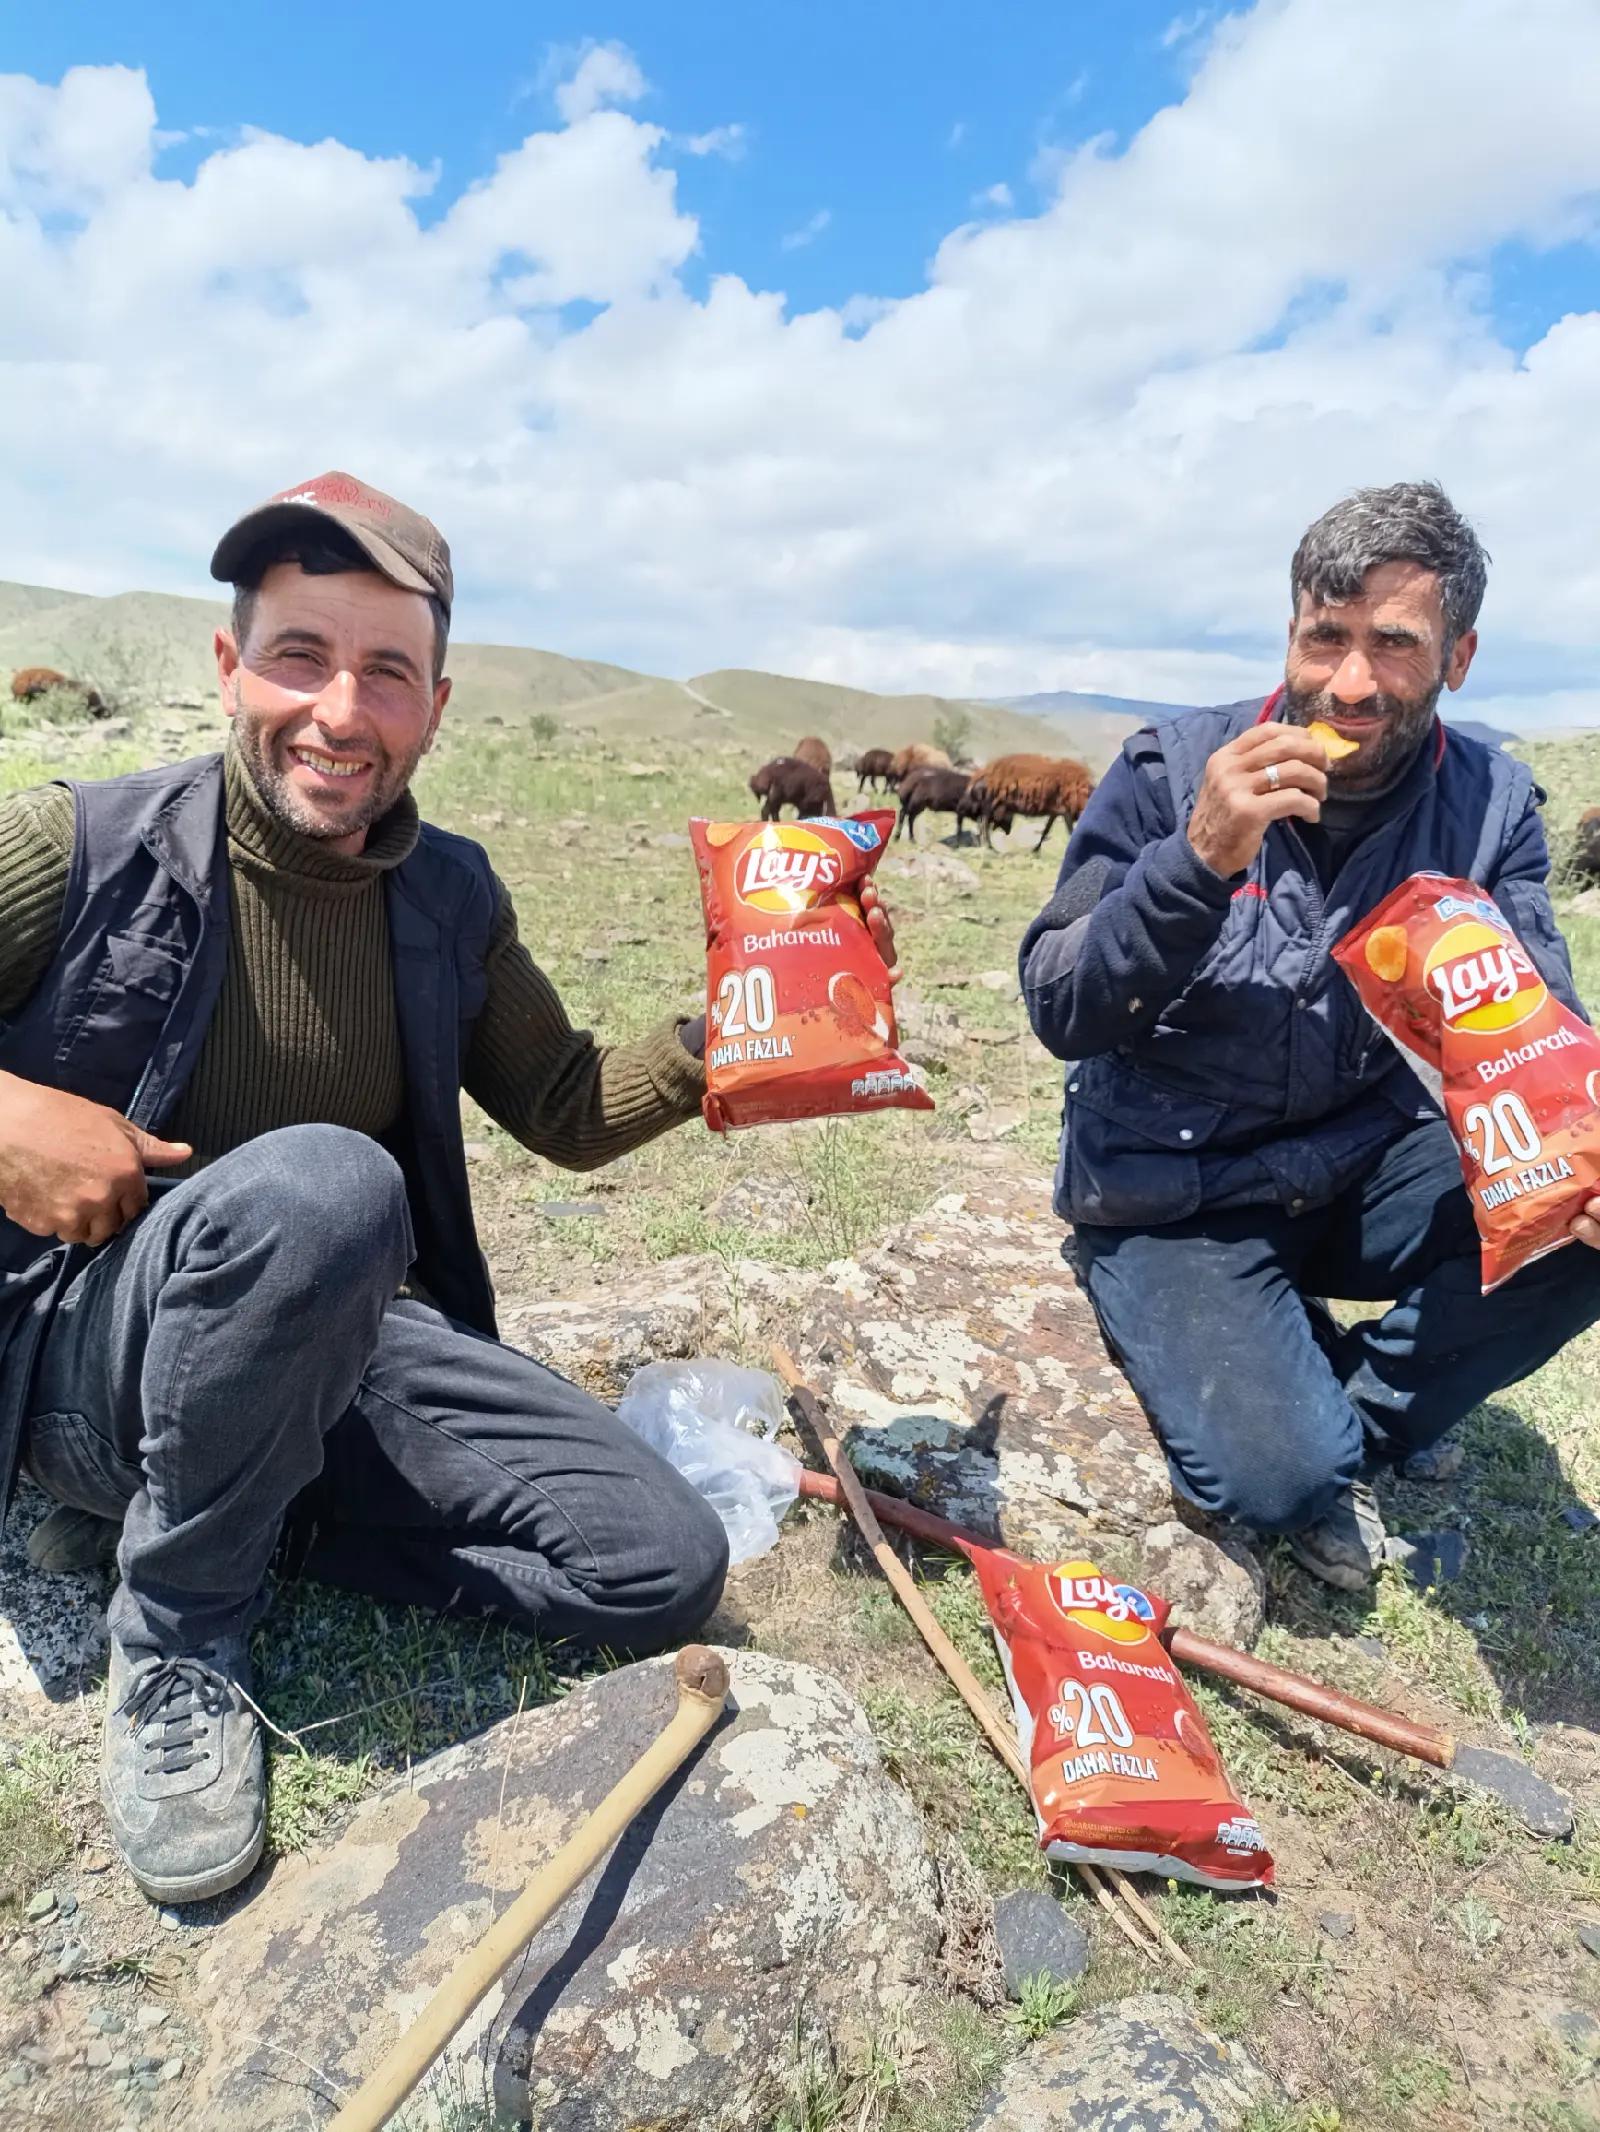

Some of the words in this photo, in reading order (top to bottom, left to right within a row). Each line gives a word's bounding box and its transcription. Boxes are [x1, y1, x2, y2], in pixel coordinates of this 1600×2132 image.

[742, 847, 839, 893] Lay's
[711, 1042, 744, 1073] DAHA
[1480, 1177, 1524, 1212] DAHA
[1062, 1750, 1111, 1785] DAHA
